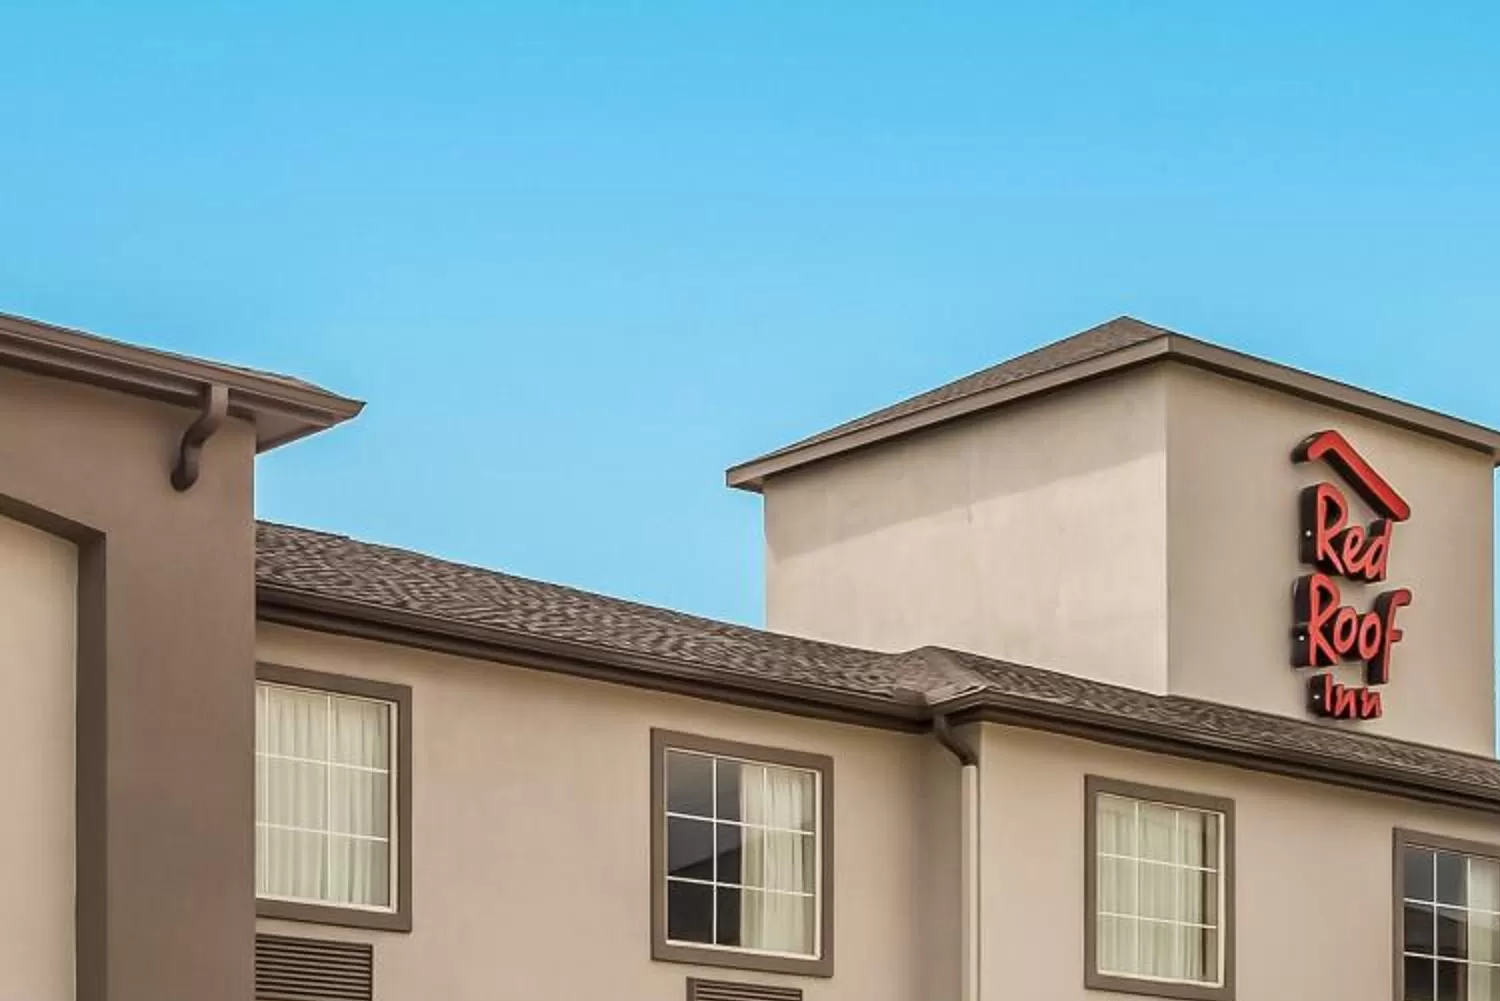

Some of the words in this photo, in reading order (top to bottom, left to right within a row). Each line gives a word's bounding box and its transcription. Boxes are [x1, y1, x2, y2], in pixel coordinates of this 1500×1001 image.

[1316, 481, 1392, 581] Red
[1307, 573, 1411, 683] Roof
[1323, 672, 1382, 718] Inn
